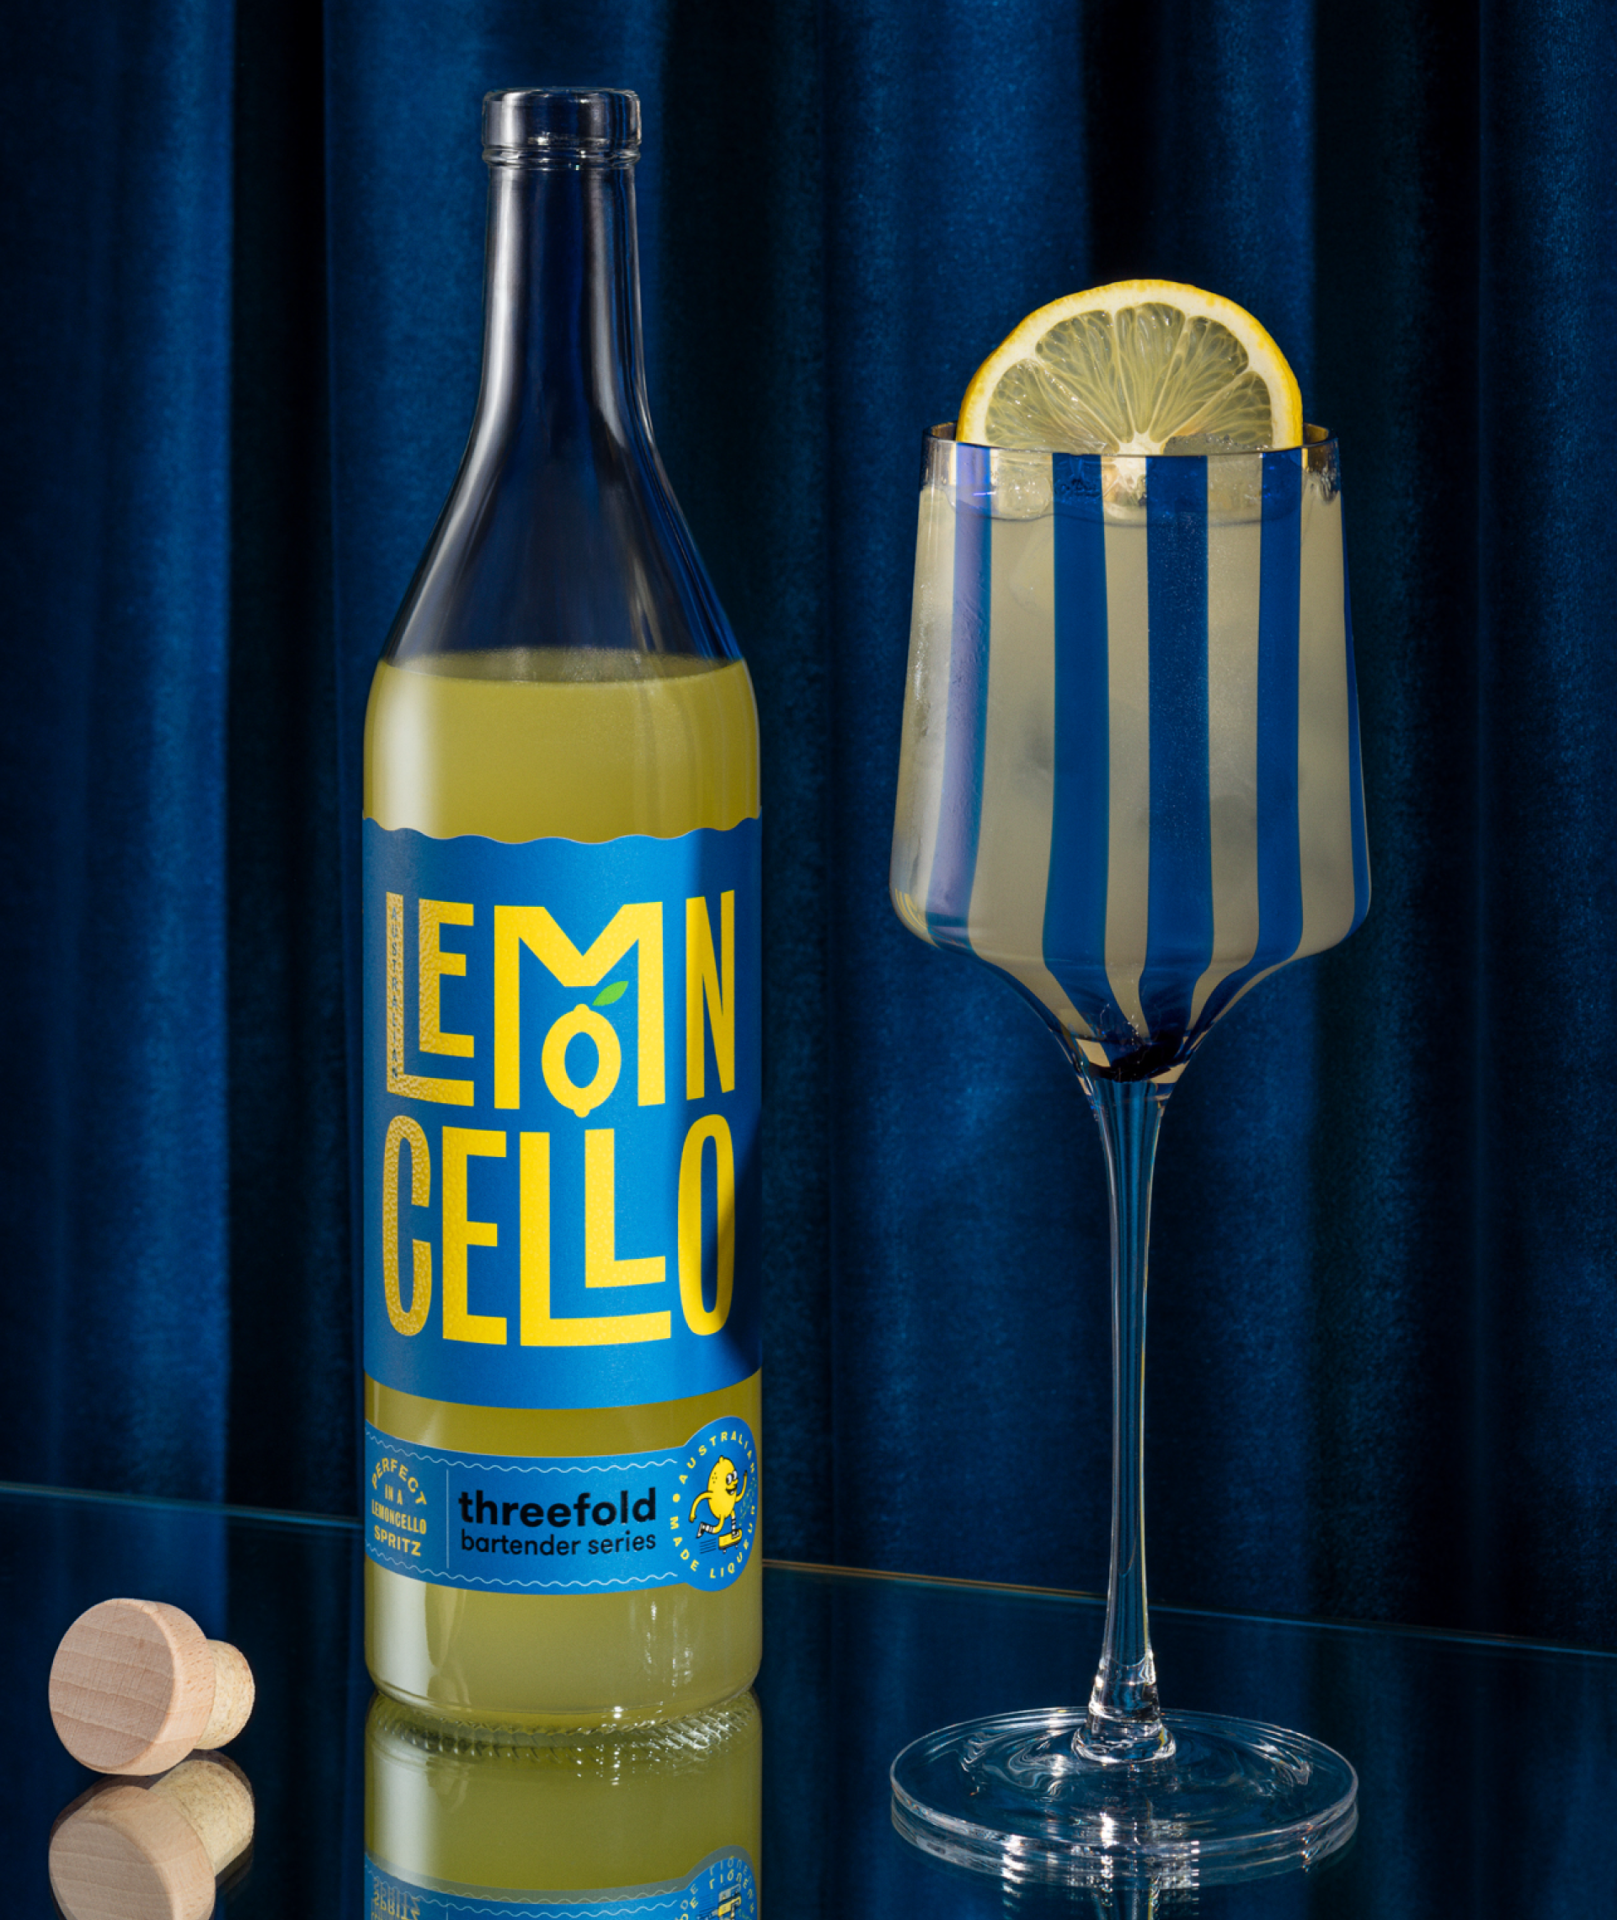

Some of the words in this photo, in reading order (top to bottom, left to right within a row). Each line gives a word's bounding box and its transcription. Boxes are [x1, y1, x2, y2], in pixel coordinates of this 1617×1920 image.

[386, 889, 735, 1118] LEMON
[382, 1114, 735, 1347] CELLO
[678, 1431, 755, 1485] AUSTRALIAN
[371, 1457, 428, 1505] PERFECT
[384, 1483, 394, 1502] IN
[397, 1489, 403, 1505] A
[371, 1499, 427, 1535] LEMONCELLO
[458, 1487, 657, 1528] threefold
[374, 1525, 422, 1557] SPRITZ
[461, 1528, 582, 1556] bartender
[588, 1529, 656, 1555] series
[670, 1516, 700, 1572] MADE
